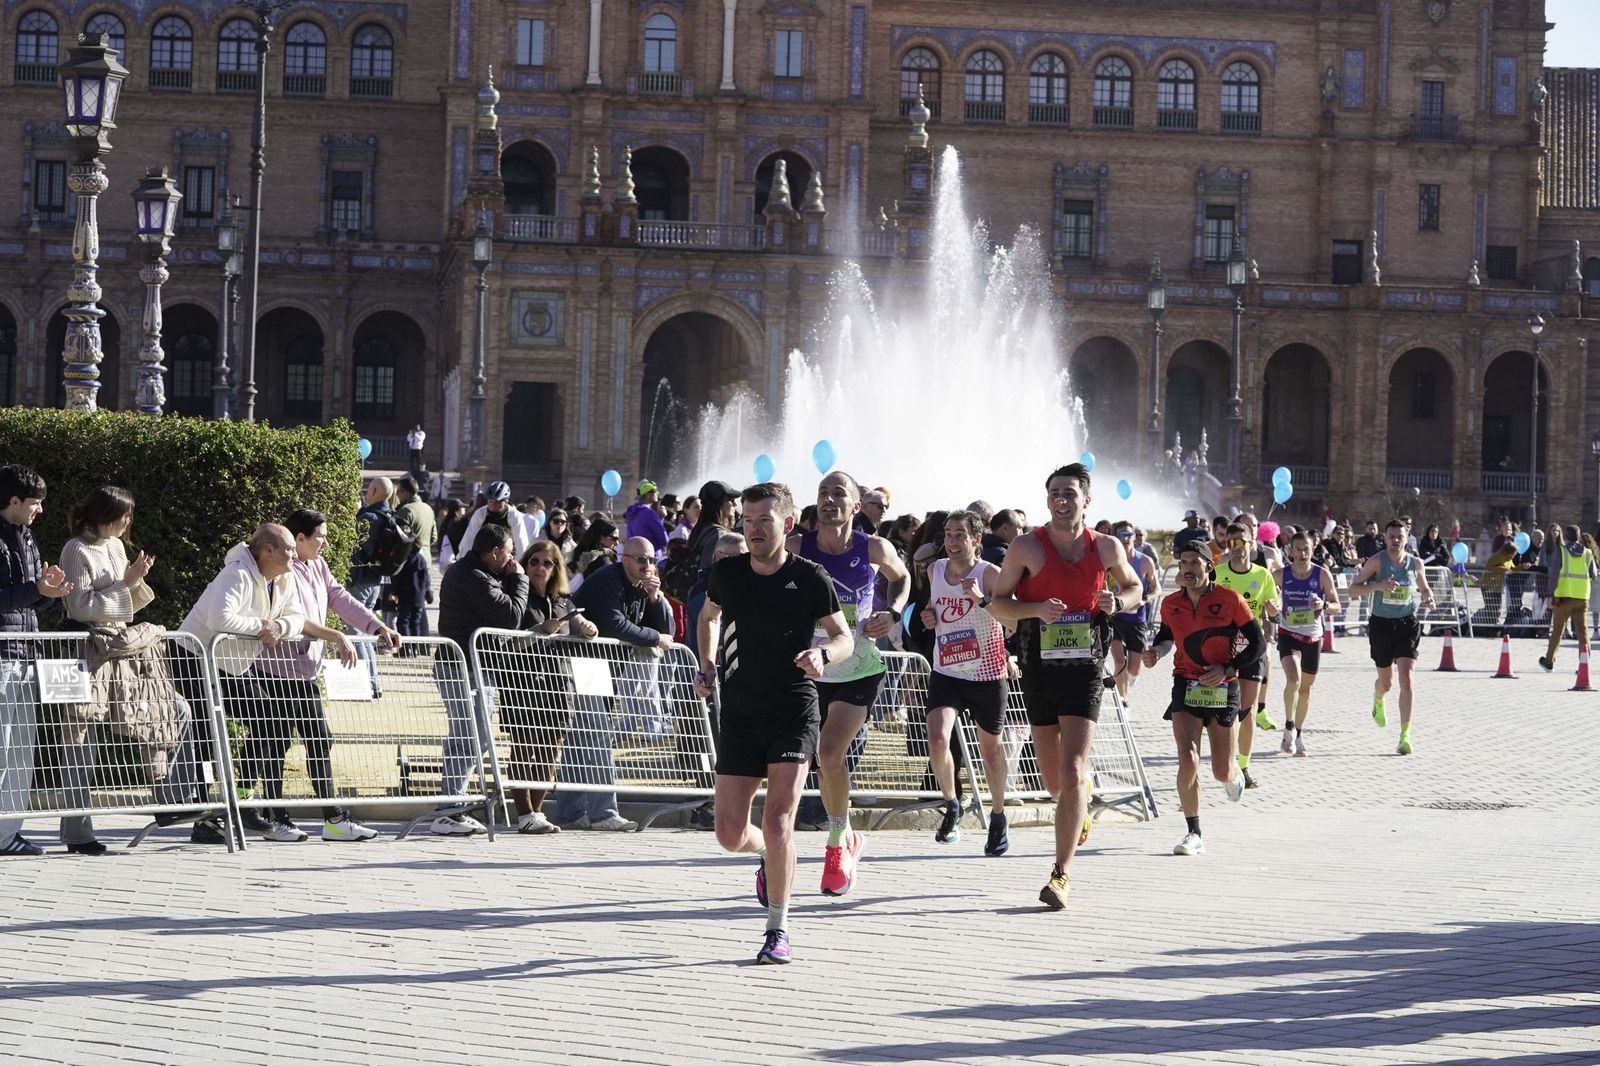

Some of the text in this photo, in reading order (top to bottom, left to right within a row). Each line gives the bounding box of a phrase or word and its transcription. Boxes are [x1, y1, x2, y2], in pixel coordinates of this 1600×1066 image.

[950, 606, 964, 616] 78
[1057, 614, 1085, 622] ZURICH
[949, 631, 971, 641] ZURICH
[1054, 637, 1079, 648] JACK
[943, 649, 977, 665] MATHIEU
[51, 665, 79, 683] AMS
[1184, 698, 1227, 707] PAULO CASTRO
